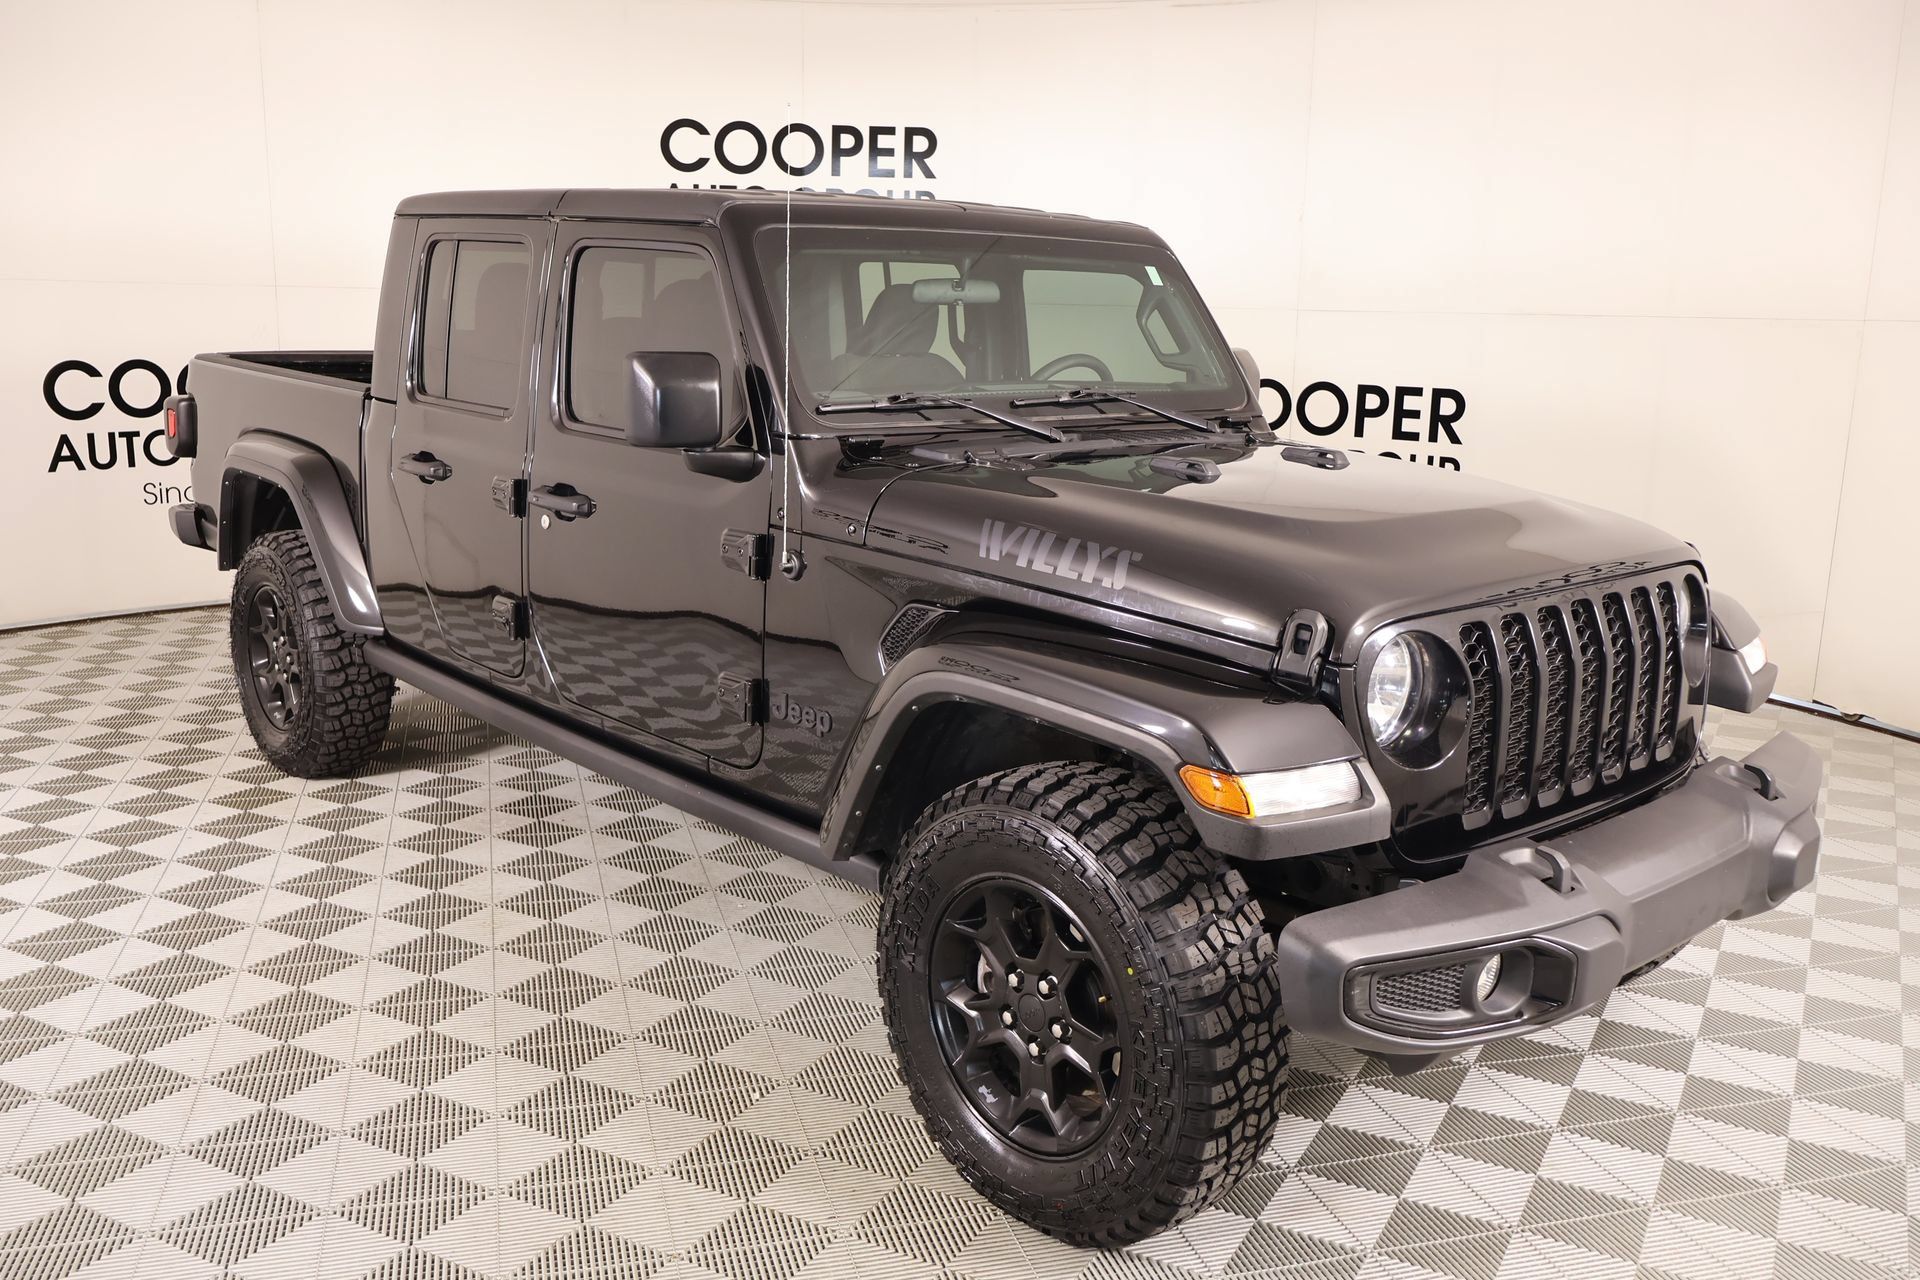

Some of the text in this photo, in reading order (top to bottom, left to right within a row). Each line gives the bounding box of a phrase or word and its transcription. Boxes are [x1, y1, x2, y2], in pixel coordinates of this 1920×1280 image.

[660, 118, 938, 179] COOPER
[43, 359, 189, 421] CO
[48, 429, 180, 473] AUTO
[979, 518, 1144, 591] WILLYS
[771, 692, 832, 738] Jeep
